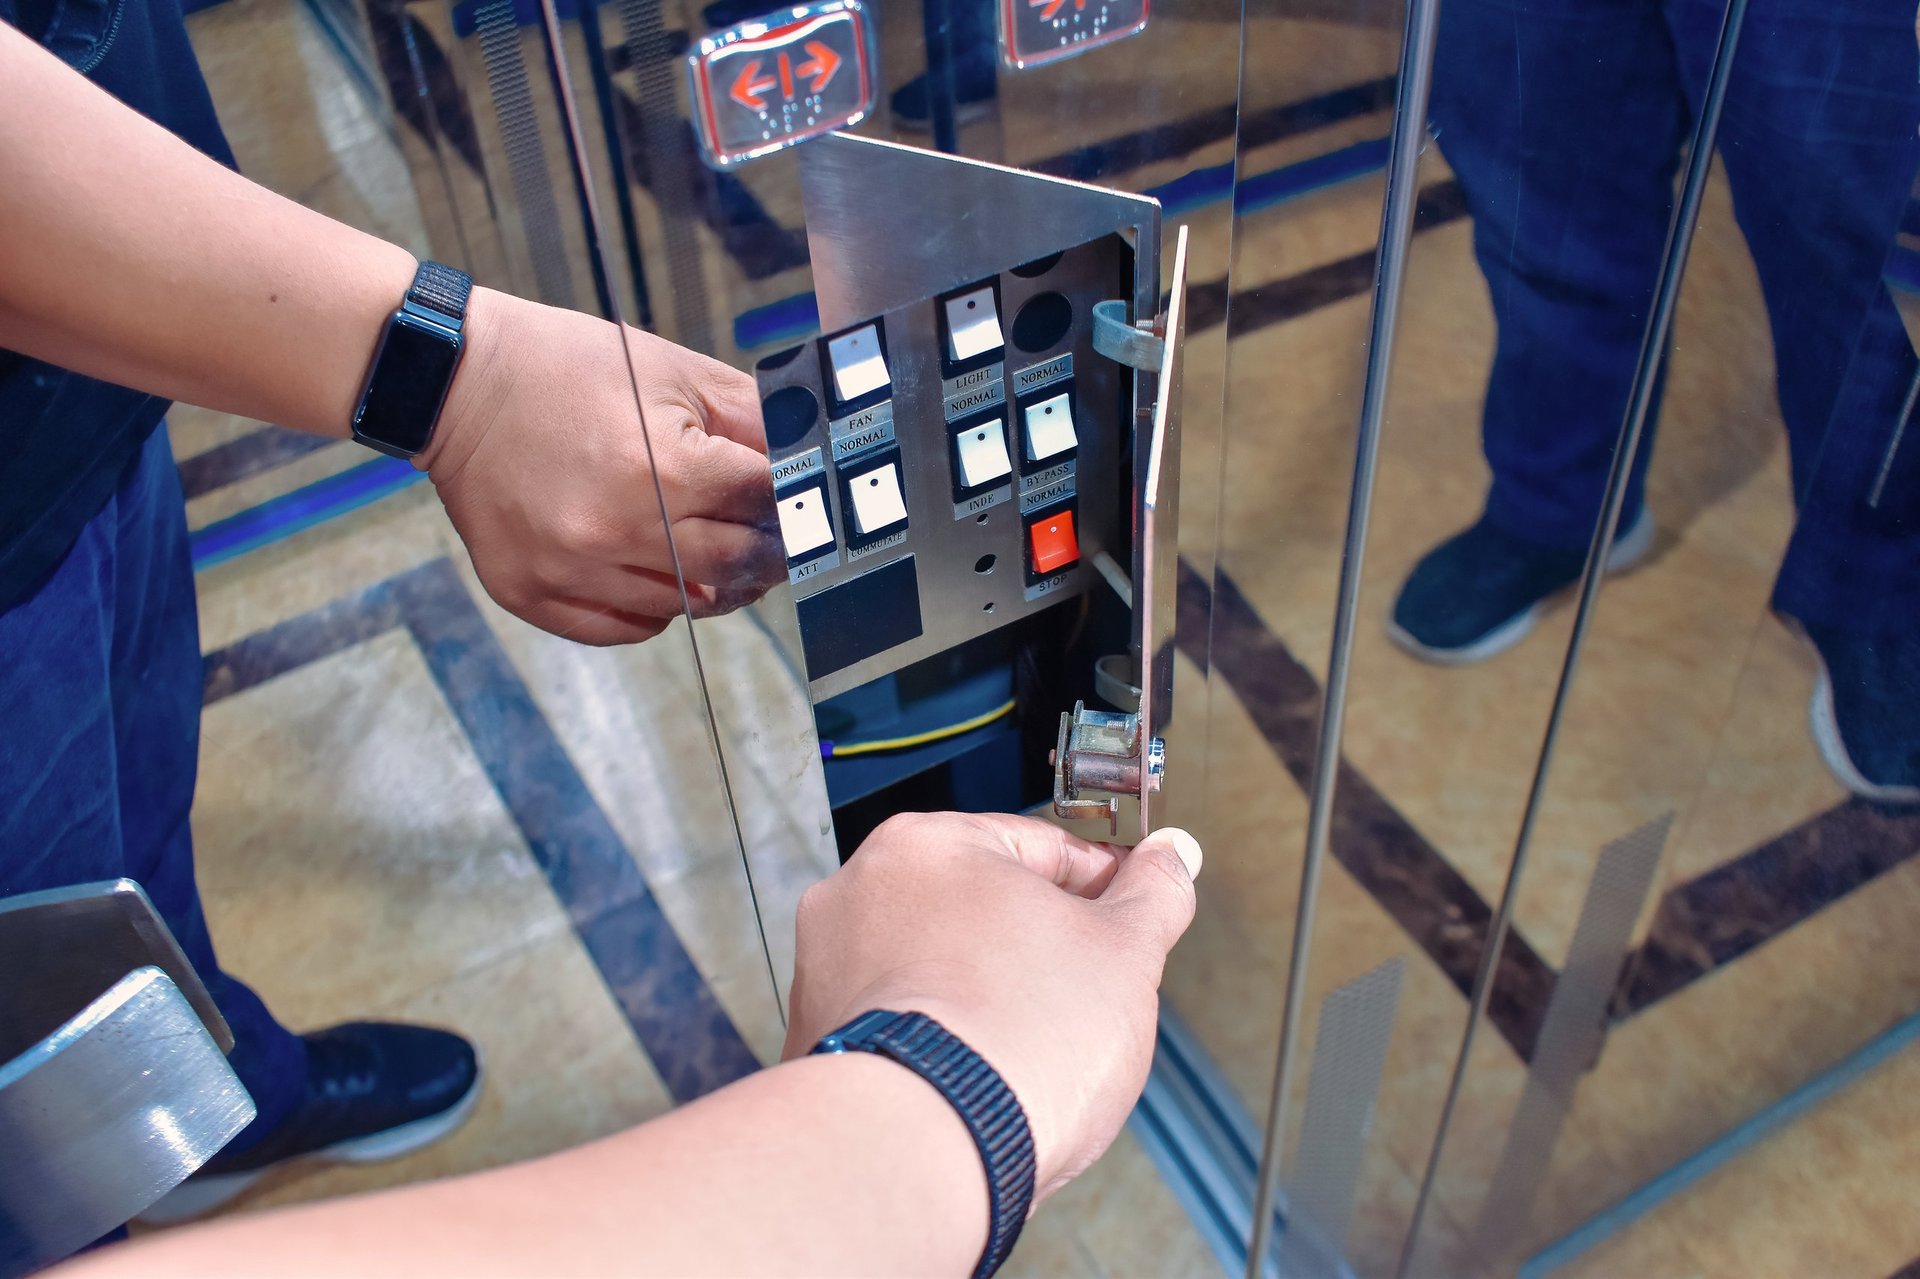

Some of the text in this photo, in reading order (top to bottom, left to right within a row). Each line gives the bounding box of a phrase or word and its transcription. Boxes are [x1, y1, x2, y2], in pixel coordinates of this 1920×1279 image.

[956, 369, 991, 389] LIGHT
[1021, 362, 1066, 386] NORMAL
[951, 389, 997, 413] NORMAL
[849, 413, 873, 430] FAN
[840, 429, 887, 454] NORMAL
[1027, 463, 1069, 487] BY-PASS
[969, 493, 994, 511] INDE
[1027, 484, 1069, 506] NORMAL
[797, 562, 818, 579] ATT
[1039, 574, 1067, 591] STOP
